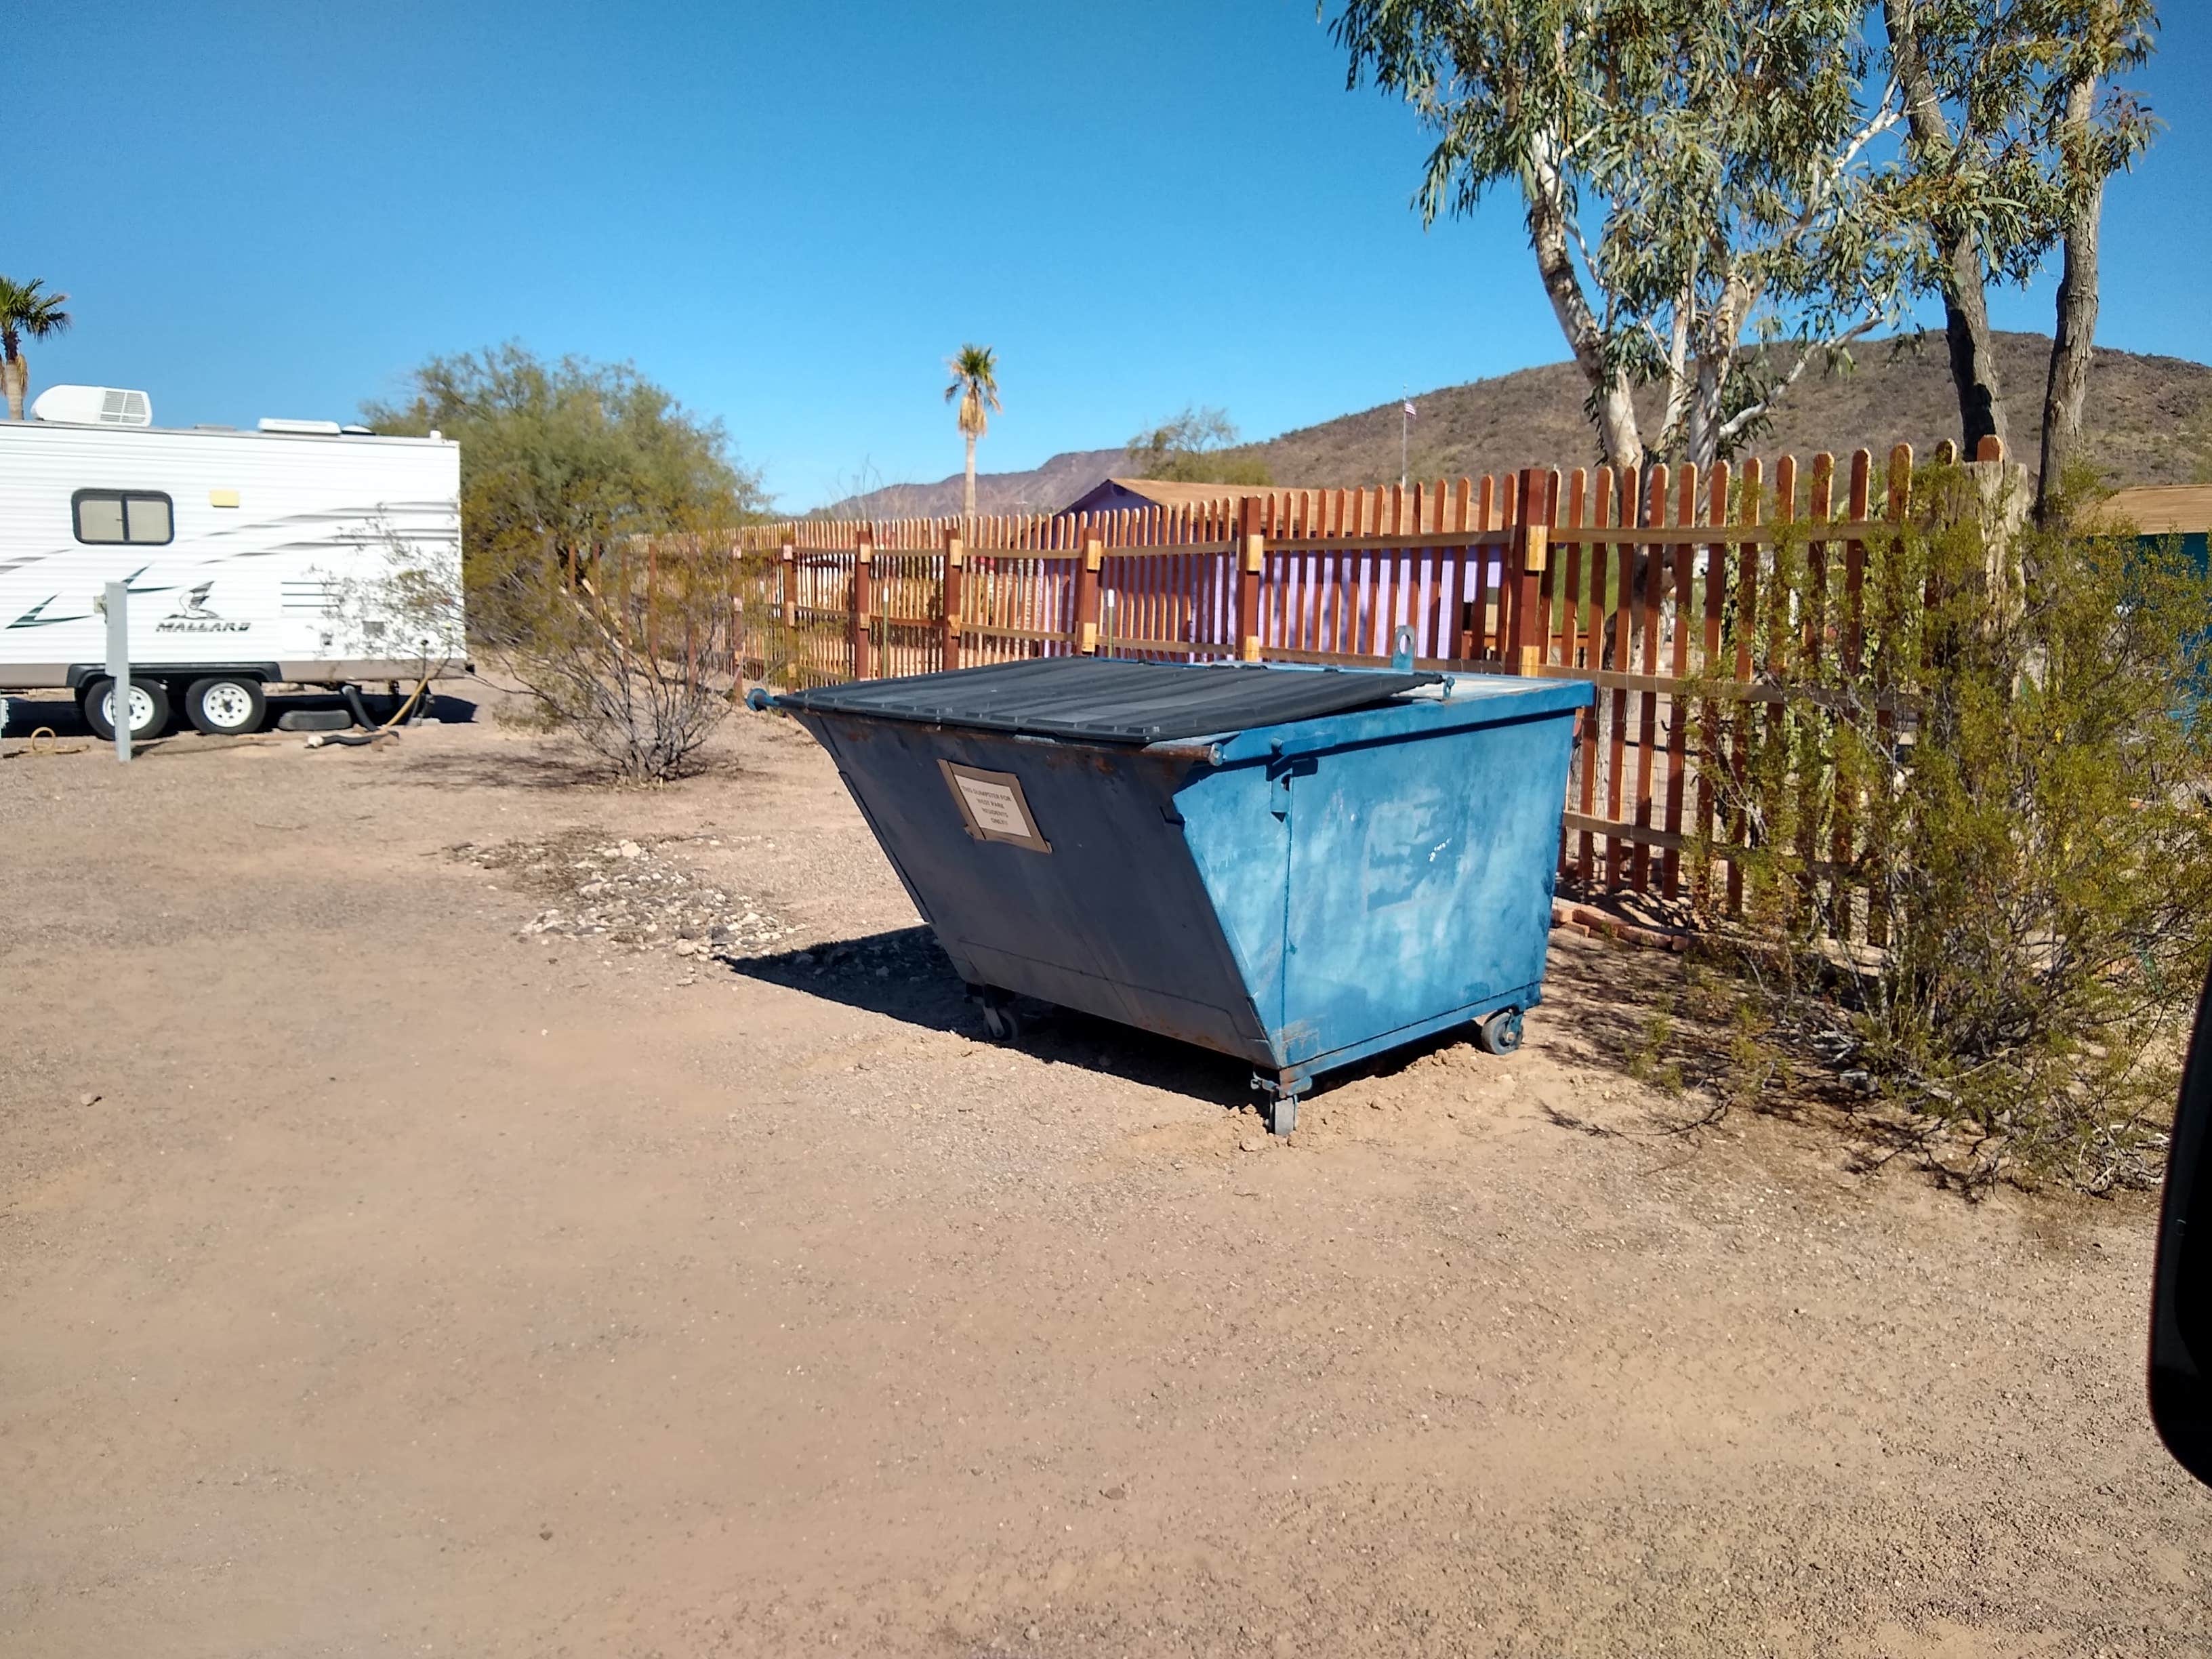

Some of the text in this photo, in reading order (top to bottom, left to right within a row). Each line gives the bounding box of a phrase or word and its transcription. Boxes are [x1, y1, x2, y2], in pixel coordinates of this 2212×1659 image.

[155, 622, 251, 632] MALLARD
[972, 789, 1000, 798] DUMPSTER
[981, 808, 1008, 817] RESIDENTS
